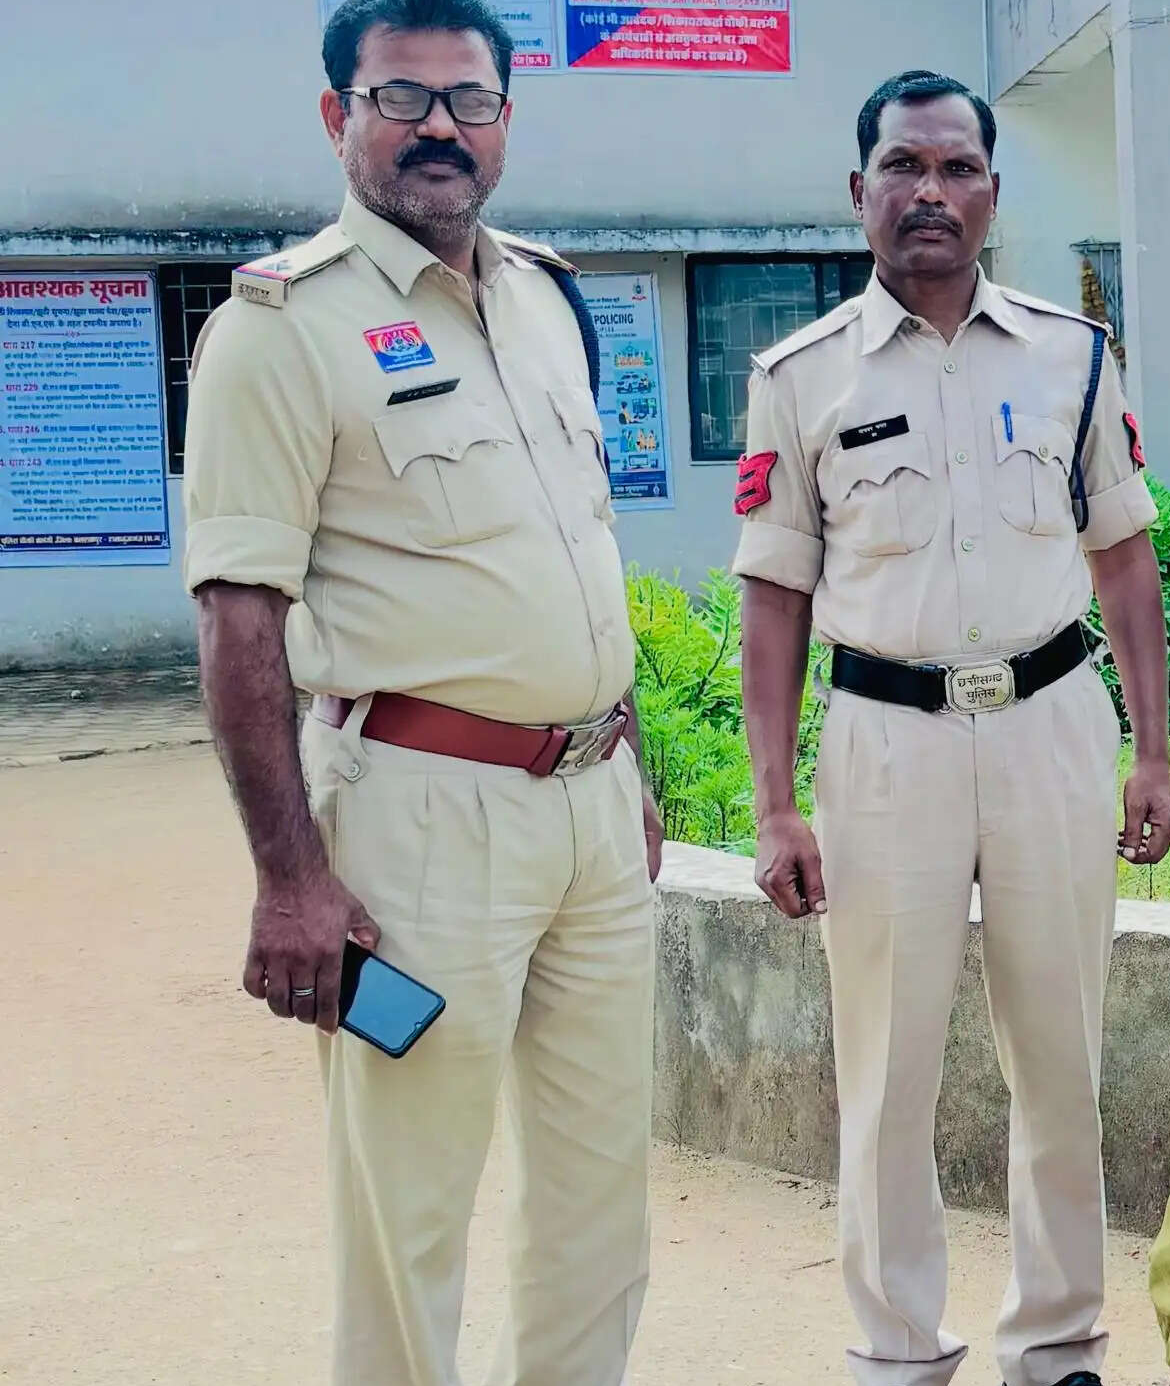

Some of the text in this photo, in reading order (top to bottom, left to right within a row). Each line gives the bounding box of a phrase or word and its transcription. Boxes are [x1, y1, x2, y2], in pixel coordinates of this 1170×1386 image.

[0, 280, 148, 304] आवश्यक सूचना
[594, 314, 634, 326] POLICING
[20, 341, 36, 350] 217
[966, 687, 997, 704] पुलिस
